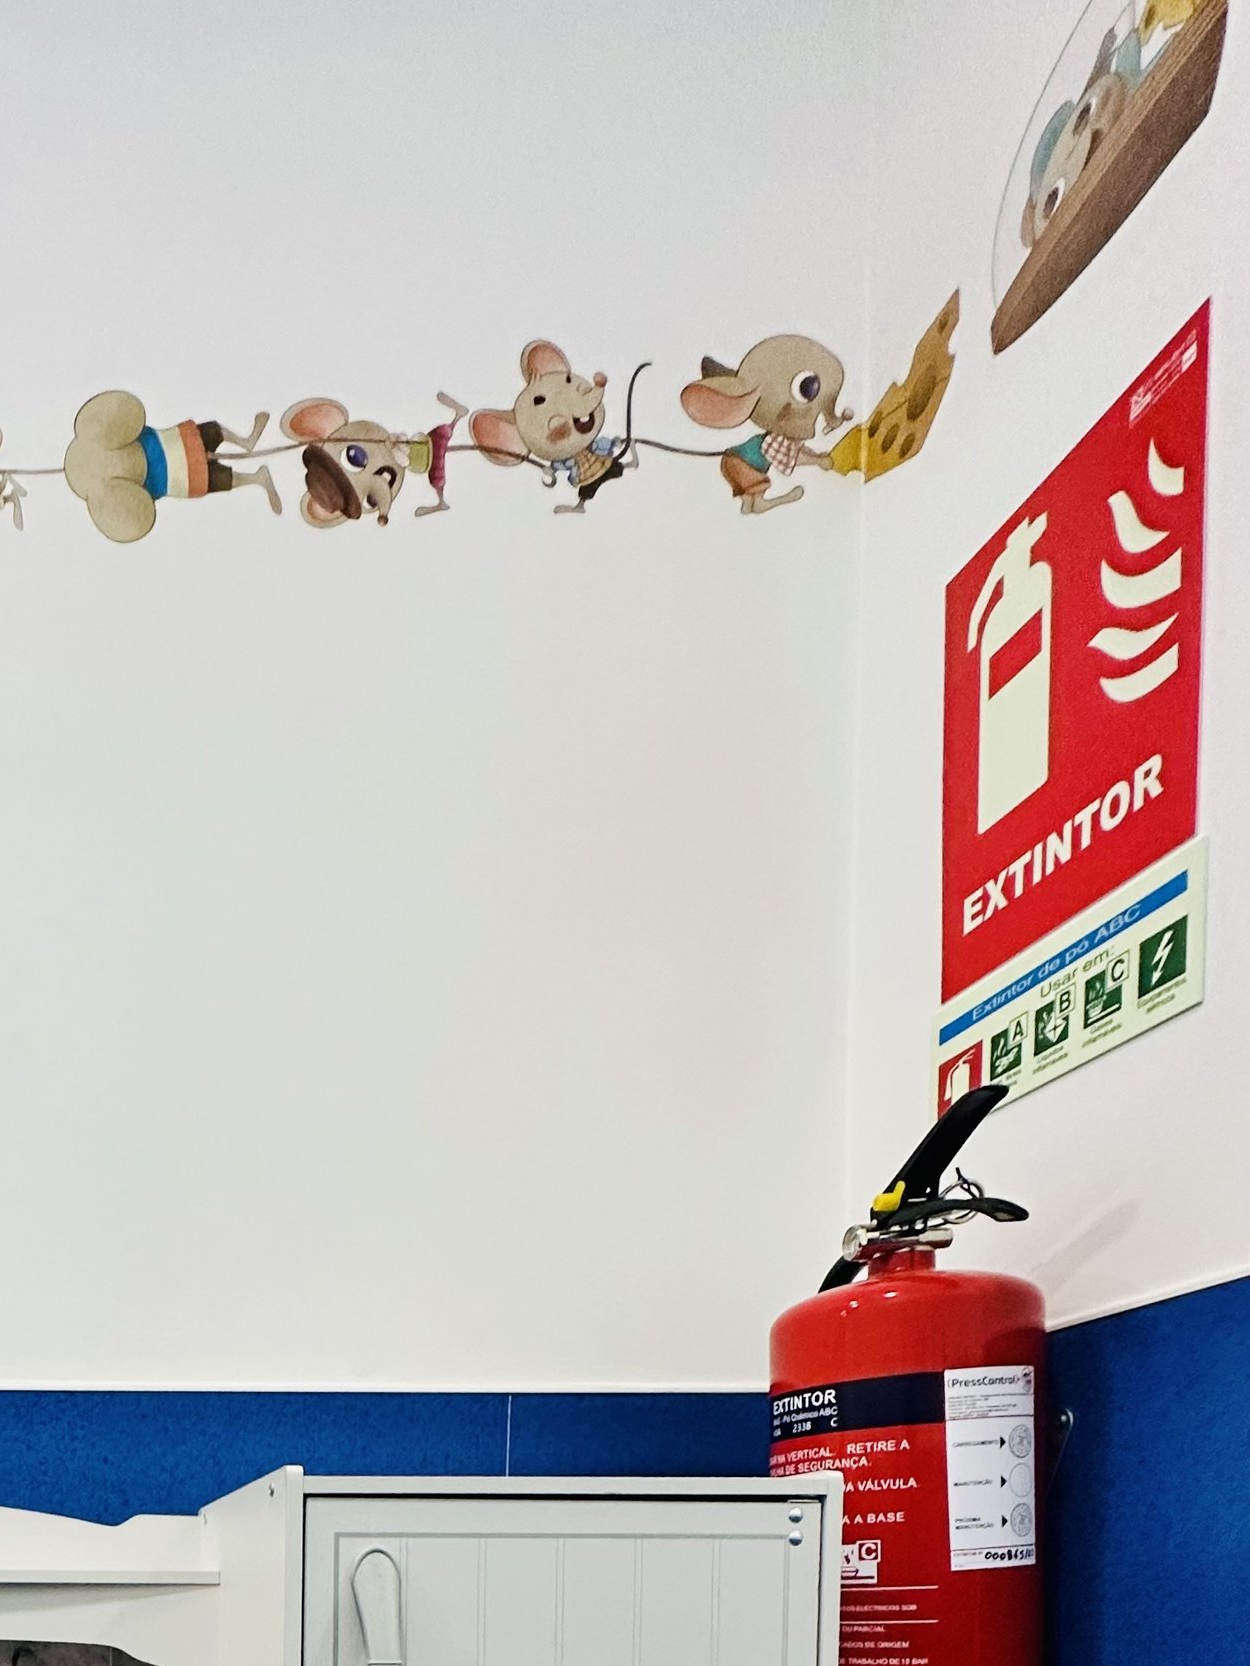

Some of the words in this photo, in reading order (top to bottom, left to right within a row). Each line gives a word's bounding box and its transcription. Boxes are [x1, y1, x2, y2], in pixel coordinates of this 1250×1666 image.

[962, 753, 1164, 936] EXTINTOR
[972, 973, 1035, 1021] Extintor
[1037, 954, 1060, 979] de
[1065, 939, 1089, 965] pó
[1094, 904, 1142, 943] ABC
[1110, 958, 1125, 982] C
[1040, 967, 1078, 998] Usar
[1059, 990, 1071, 1014] B
[1012, 1020, 1024, 1041] A
[951, 1375, 1016, 1388] PressControl
[773, 1389, 837, 1415] EXTINTOR
[818, 1406, 838, 1417] ABC
[830, 1417, 838, 1427] C
[847, 1440, 896, 1455] RETIRE
[900, 1439, 910, 1450] A
[786, 1465, 796, 1475] DE
[854, 1514, 863, 1524] A
[867, 1511, 905, 1524] BASE
[860, 1543, 877, 1560] C
